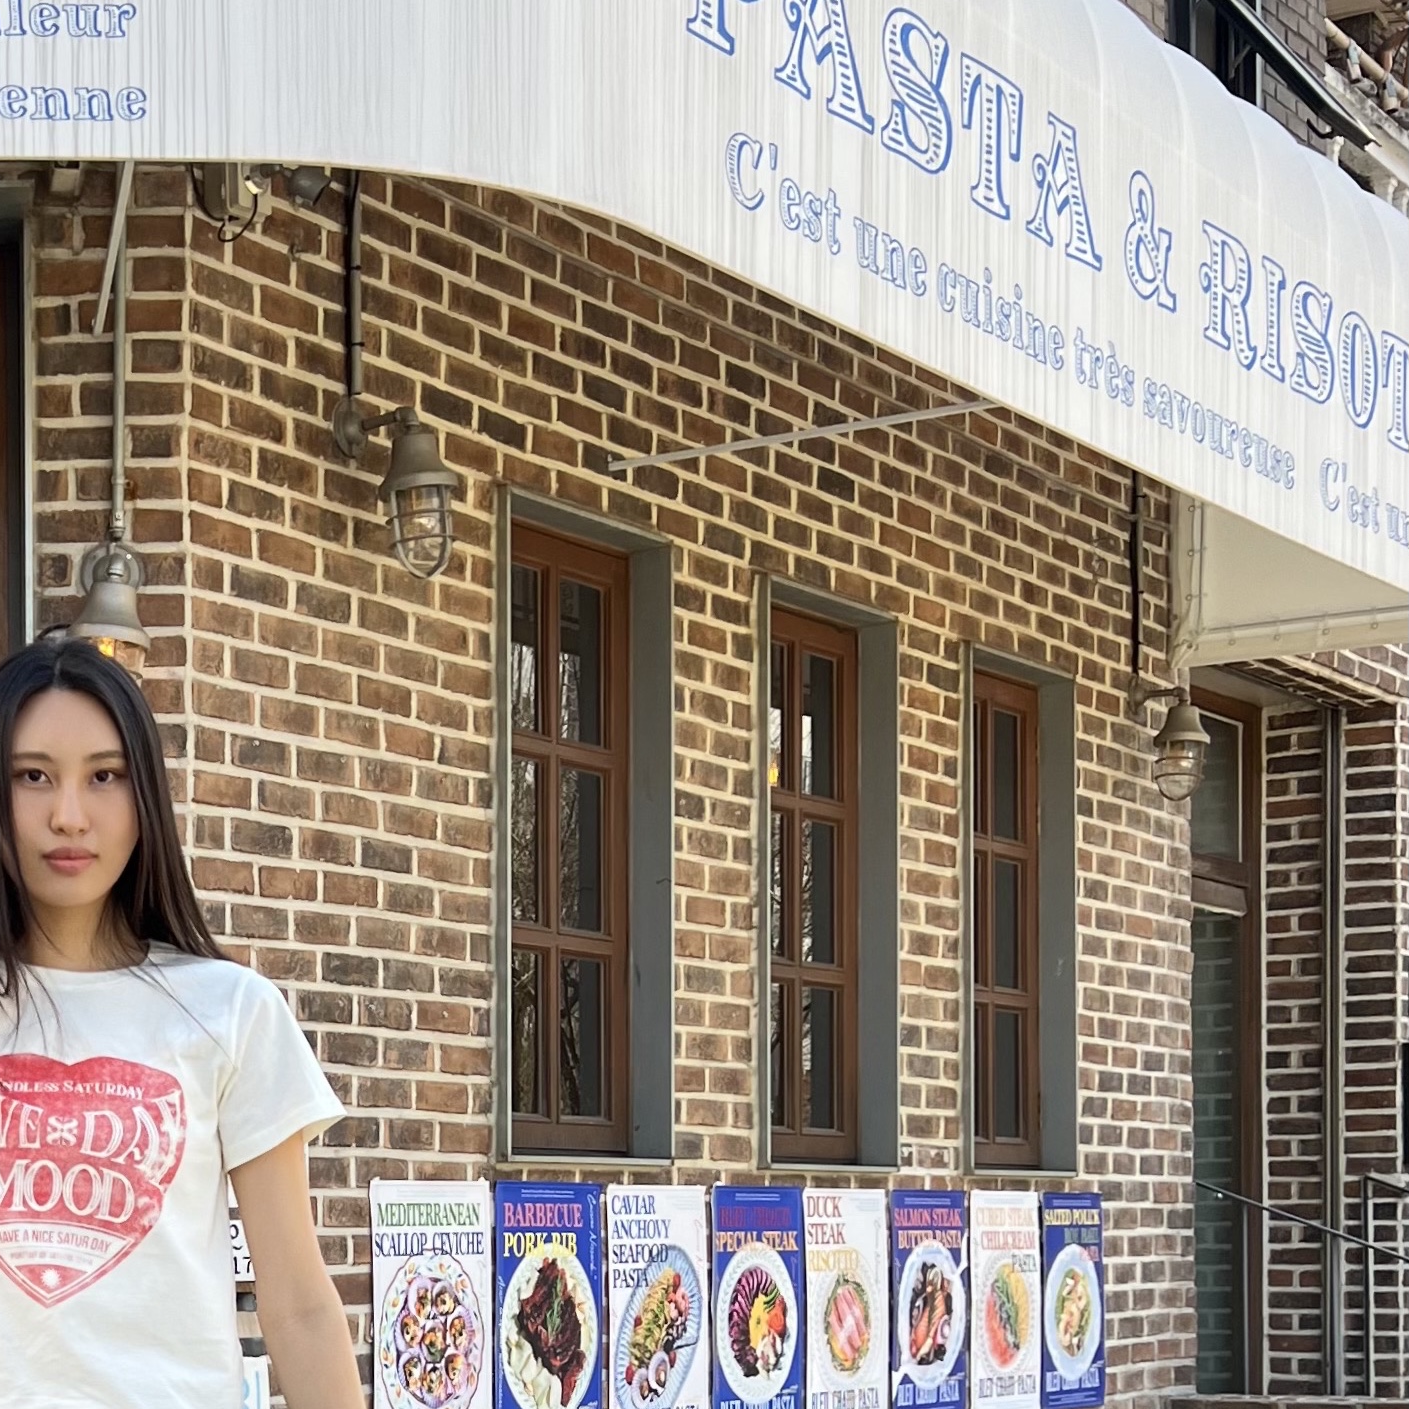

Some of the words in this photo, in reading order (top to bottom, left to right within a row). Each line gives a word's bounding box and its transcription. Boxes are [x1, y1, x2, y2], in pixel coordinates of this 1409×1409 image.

[1124, 170, 1177, 313] &
[725, 132, 841, 255] C'est
[853, 216, 927, 296] une
[936, 262, 1065, 370] cuisine
[1073, 327, 1135, 407] très
[1143, 377, 1295, 489] savoureuse
[1319, 457, 1380, 533] C'est
[62, 1080, 145, 1100] SATURDAY
[79, 1088, 182, 1190] DAY
[376, 1203, 480, 1227] MEDITERRANEAN
[503, 1203, 583, 1227] BARBECUE
[611, 1194, 656, 1215] CAVIAR
[806, 1196, 842, 1218] DUCK
[894, 1208, 931, 1227] SALMON
[932, 1208, 963, 1227] STEAK
[1008, 1207, 1036, 1227] STEAK
[22, 1230, 31, 1243] A
[32, 1230, 54, 1243] NICE
[611, 1219, 671, 1240] ANCHOVY
[807, 1223, 846, 1245] STEAK
[898, 1229, 933, 1249] BUTTER
[934, 1230, 962, 1249] PASTA
[375, 1232, 428, 1257] SCALLOP
[433, 1232, 484, 1256] CEVICHE
[503, 1232, 548, 1257] PORK
[761, 1231, 799, 1251] STEAK
[612, 1243, 669, 1264] SEAFOOD
[808, 1249, 859, 1272] RISOTTO
[1011, 1253, 1038, 1273] PASTA
[612, 1268, 649, 1289] PASTA
[858, 1387, 880, 1409] PASTA
